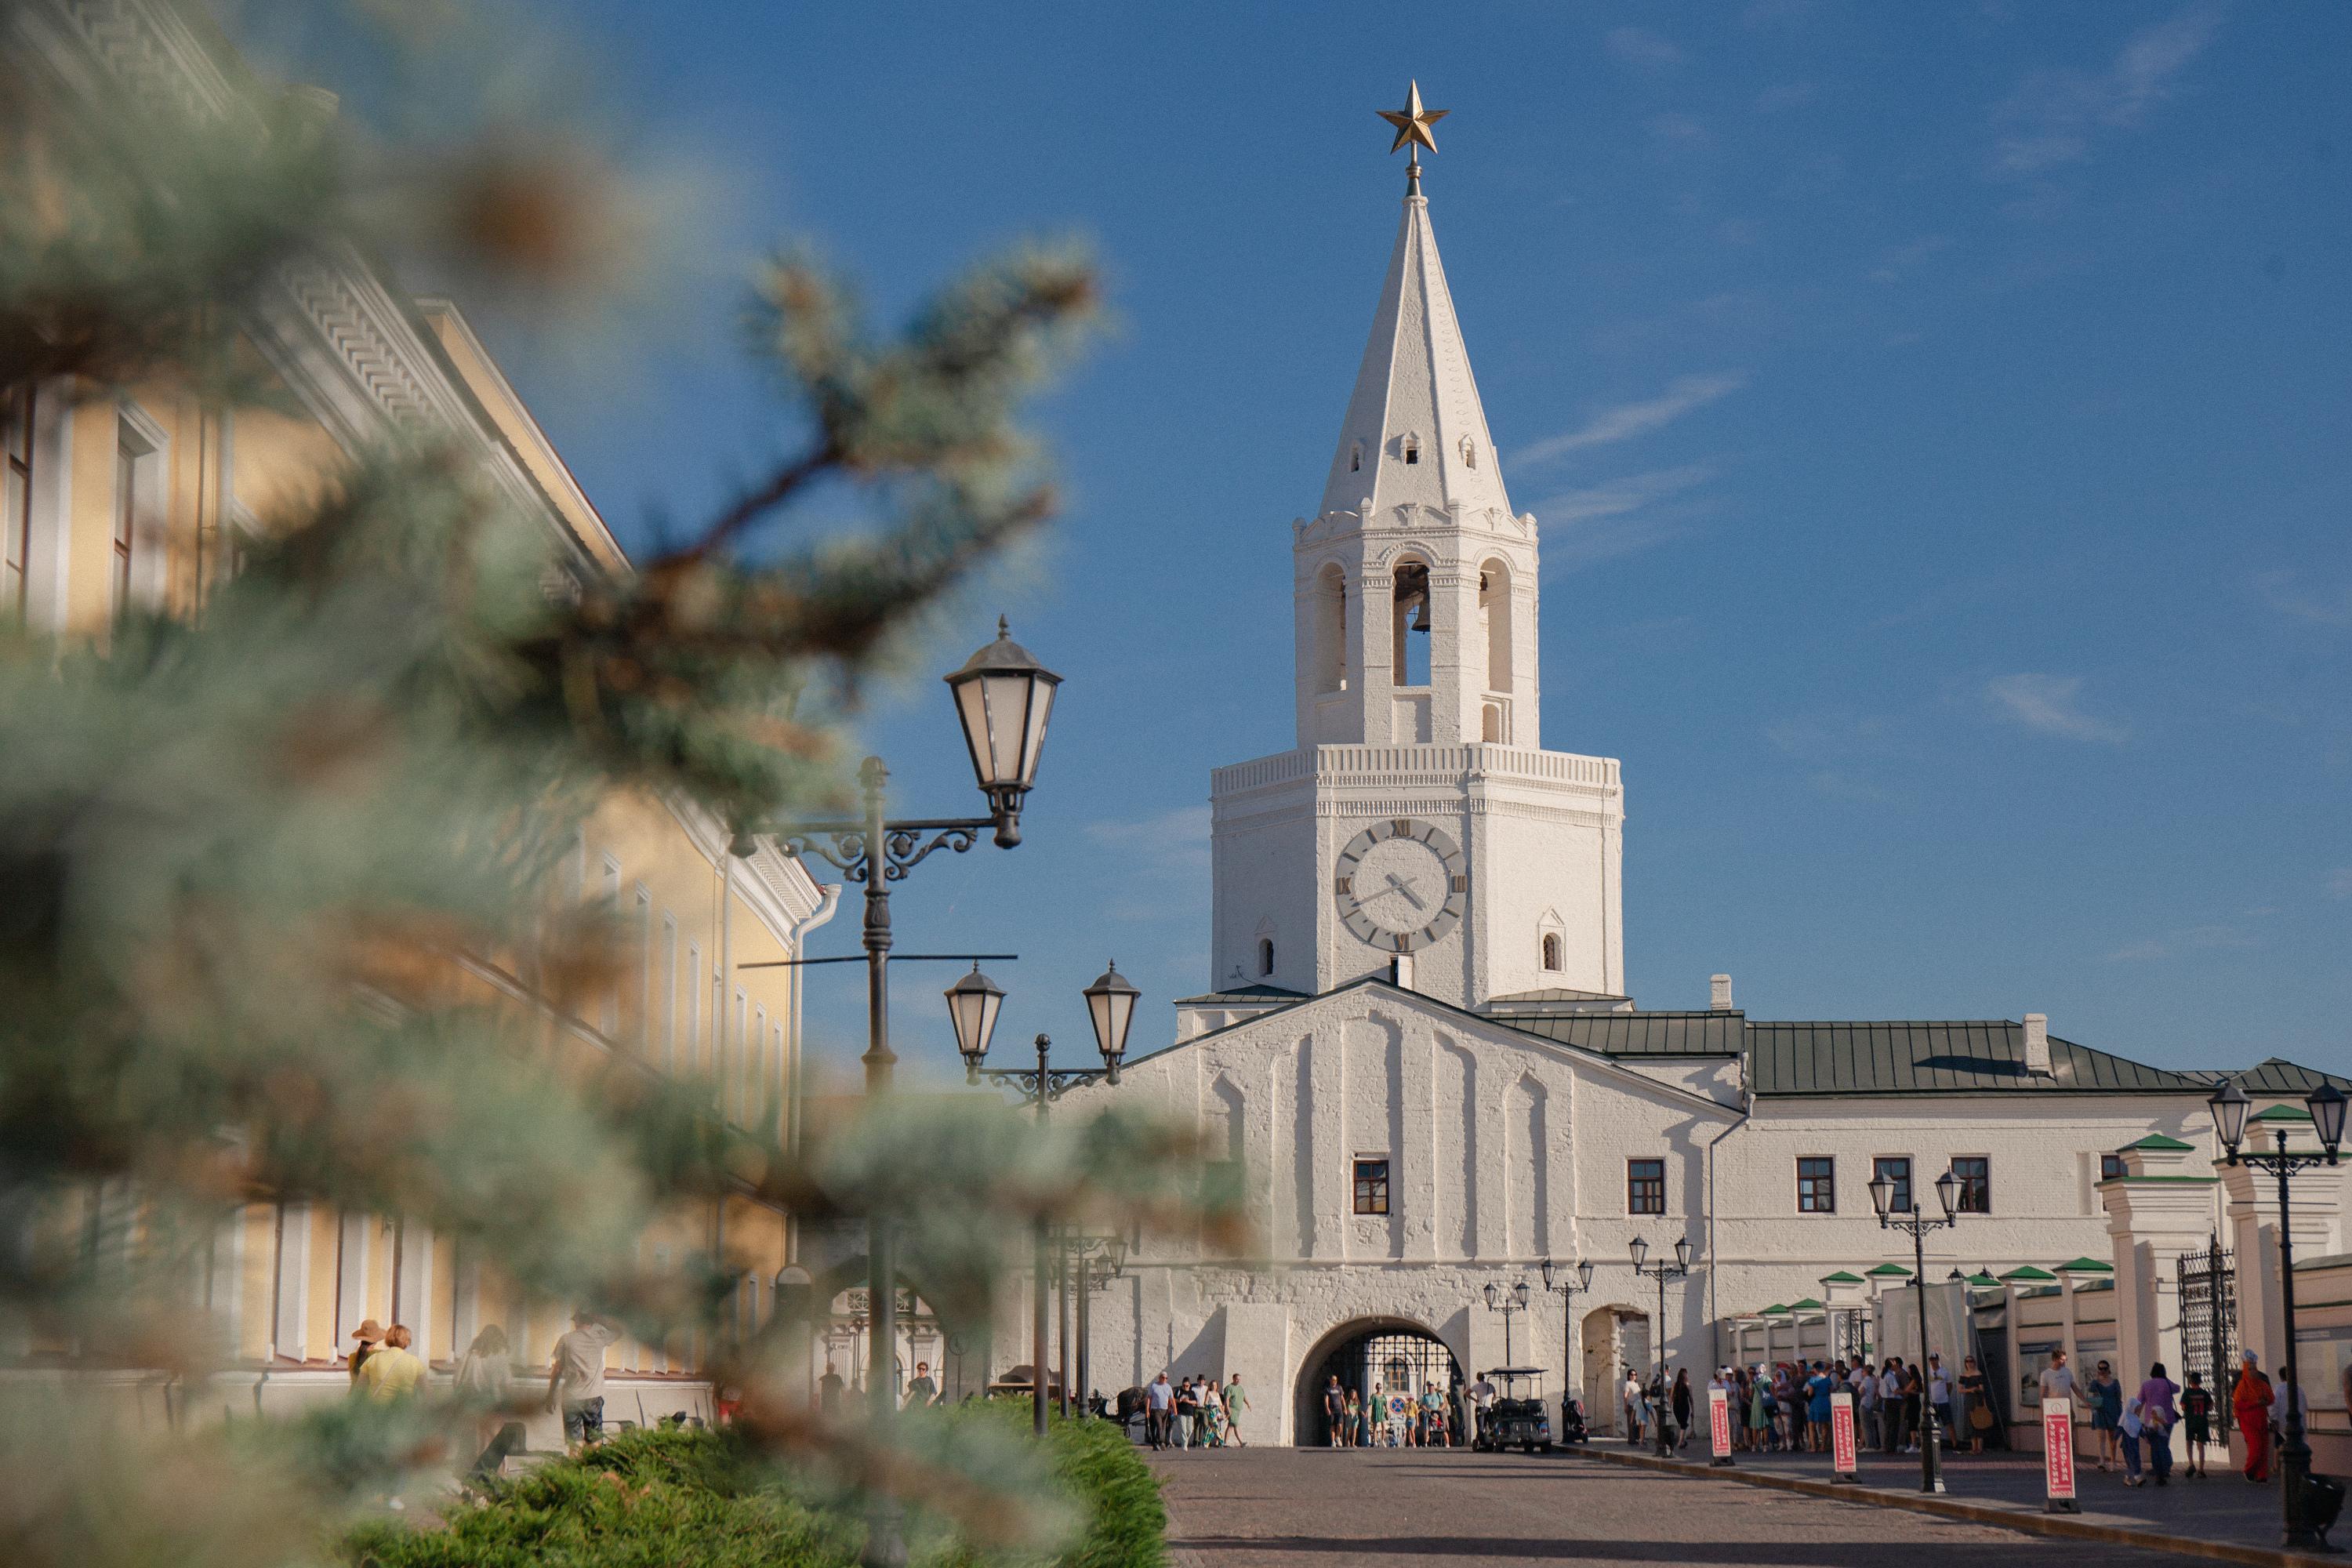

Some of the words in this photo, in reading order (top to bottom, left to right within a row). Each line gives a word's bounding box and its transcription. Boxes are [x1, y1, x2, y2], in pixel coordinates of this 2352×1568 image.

[1393, 819, 1411, 837] XII
[1336, 877, 1351, 895] IX
[1453, 875, 1468, 893] III
[1394, 933, 1410, 950] VI
[2049, 1423, 2059, 1484] ЭКСКУРСИИ
[2059, 1427, 2069, 1481] АУДИОГИД
